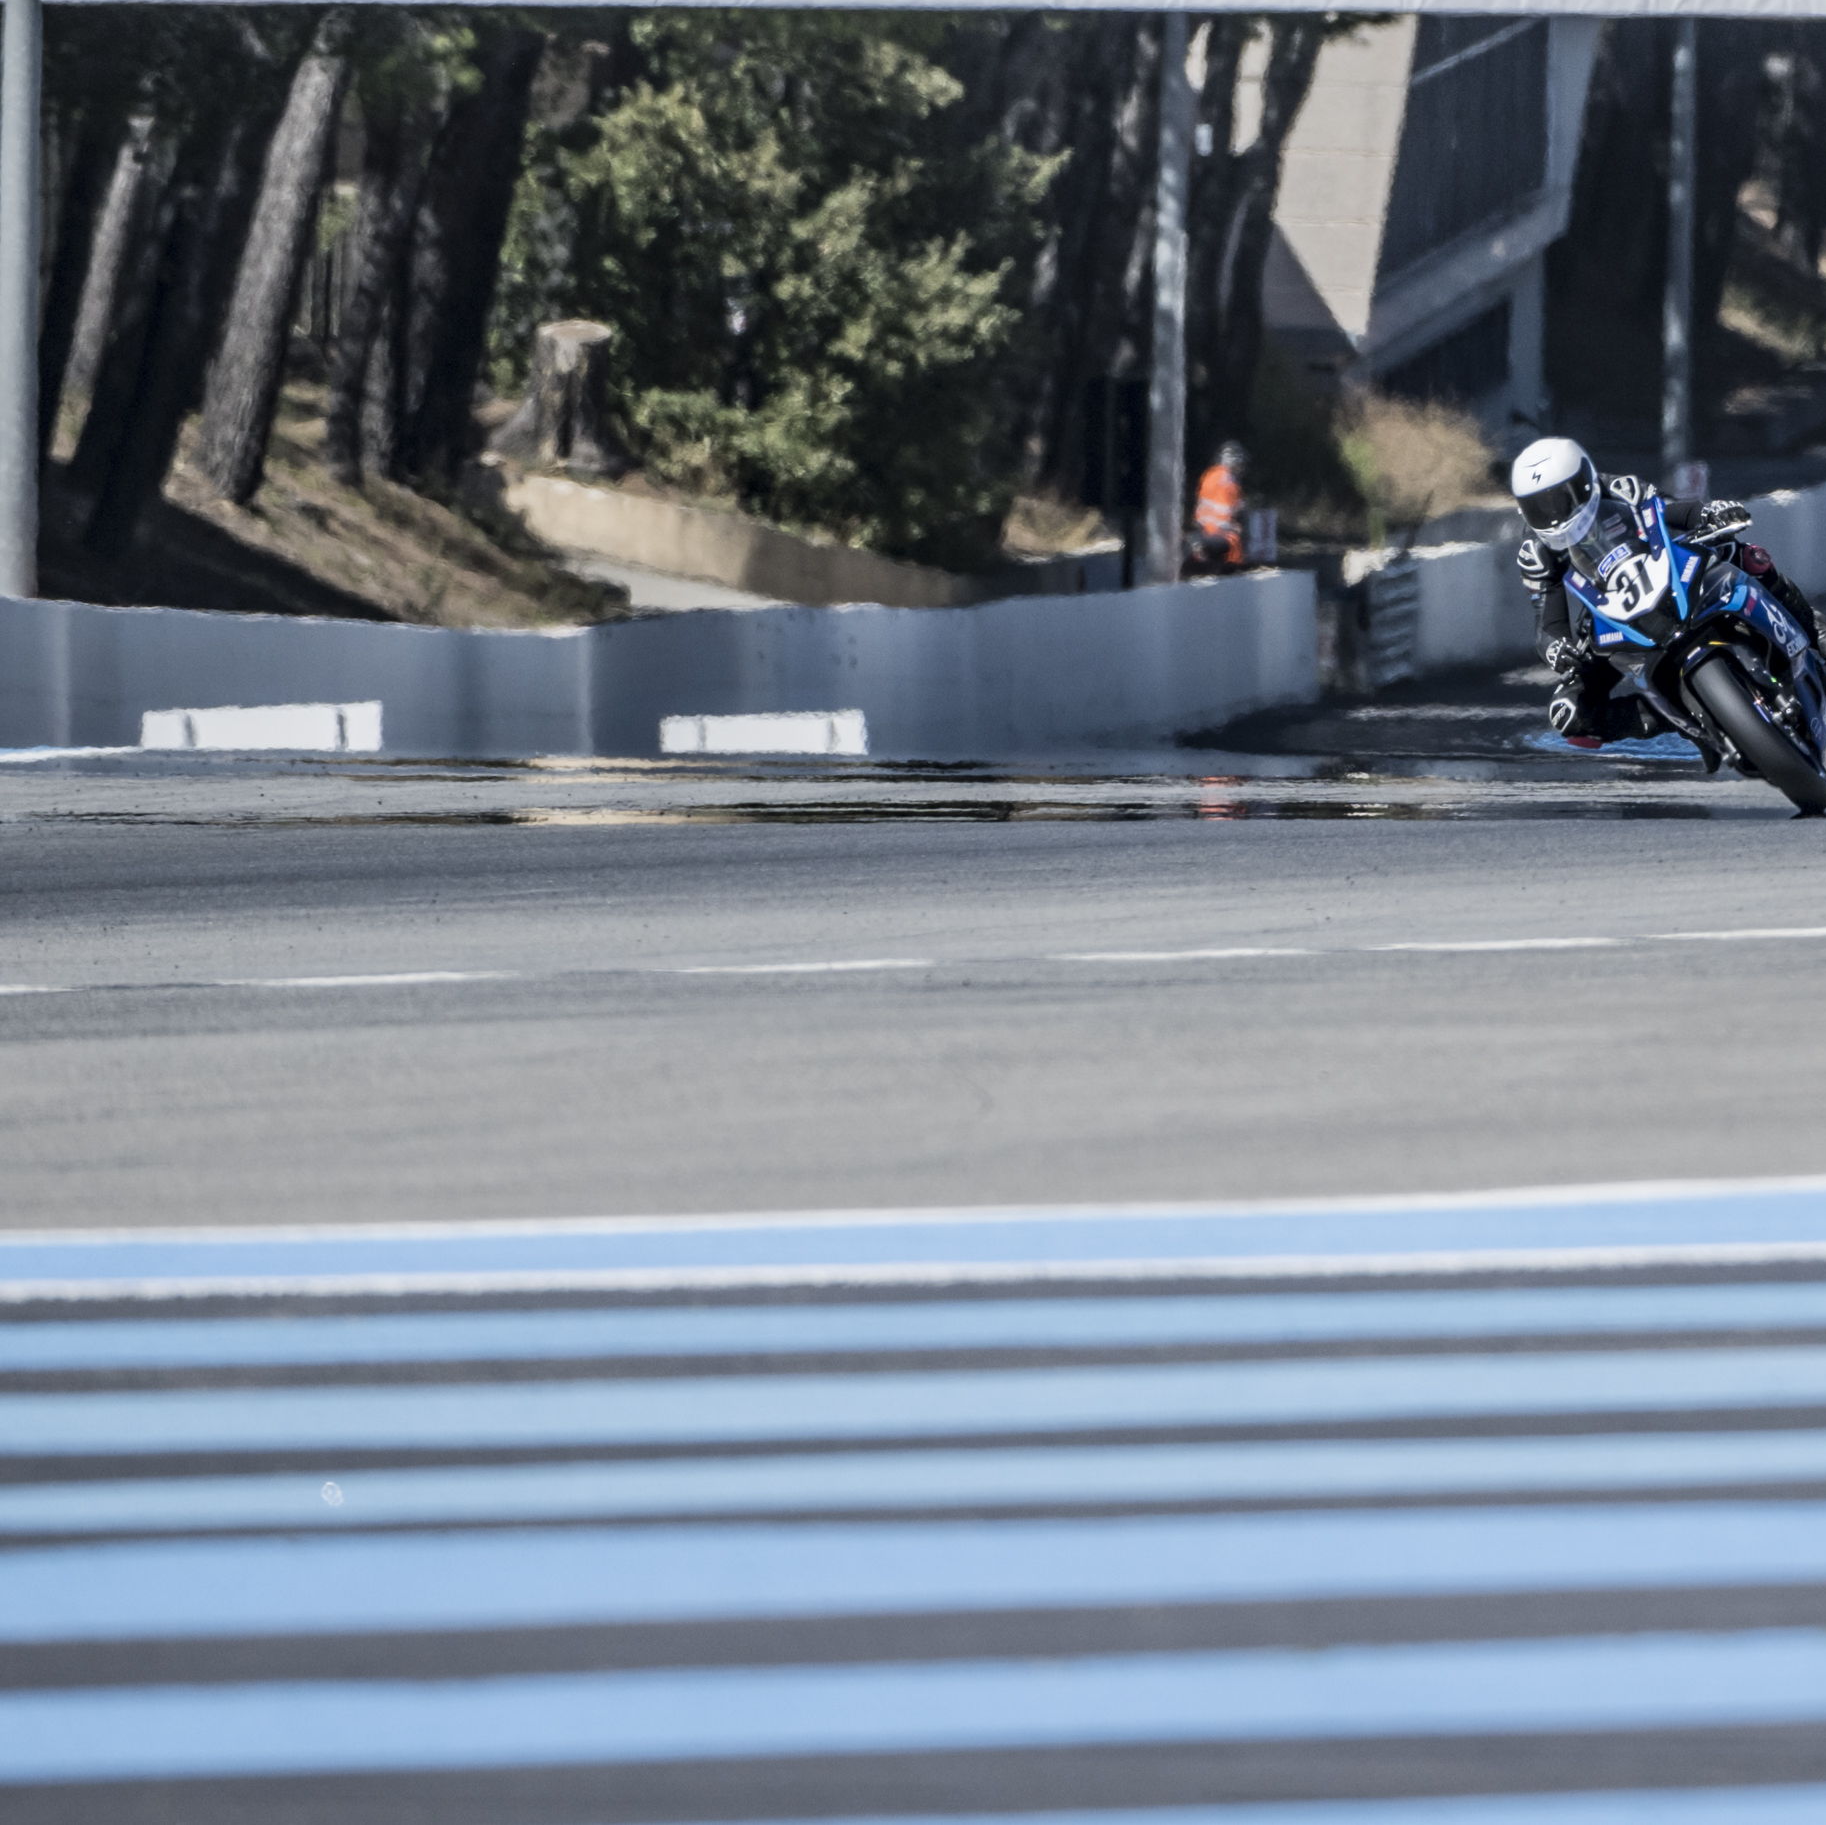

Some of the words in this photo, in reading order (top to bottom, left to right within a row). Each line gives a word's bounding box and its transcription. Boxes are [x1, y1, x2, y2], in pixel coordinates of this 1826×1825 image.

[1680, 555, 1700, 583] YAMAHA
[1615, 556, 1655, 612] 31
[1599, 631, 1624, 645] YAMAHA
